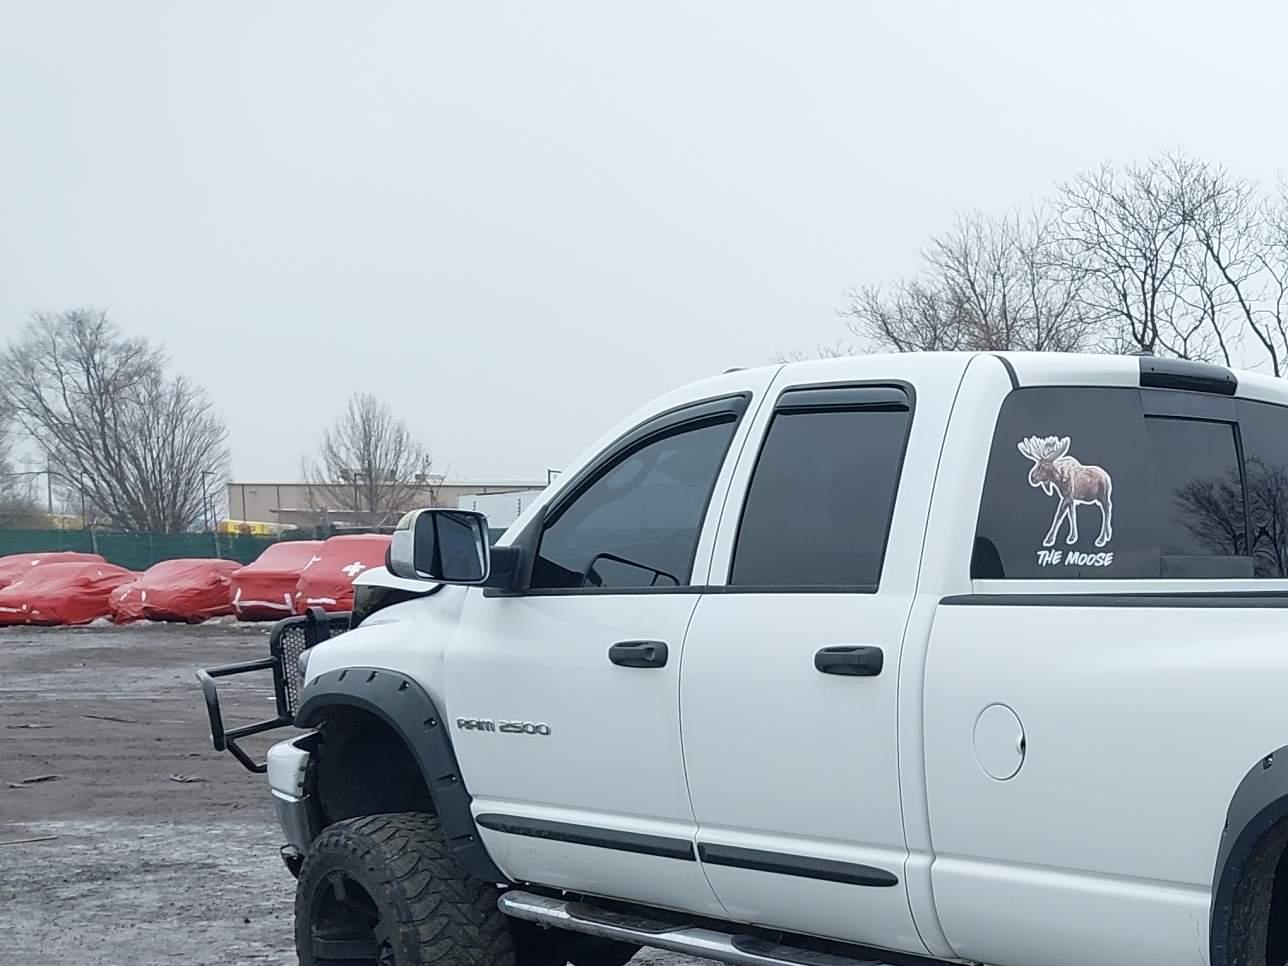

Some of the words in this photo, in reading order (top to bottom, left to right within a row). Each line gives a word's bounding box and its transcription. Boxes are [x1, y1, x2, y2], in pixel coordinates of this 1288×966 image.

[1036, 549, 1063, 567] THE
[1064, 550, 1114, 567] MOOSE
[457, 718, 496, 733] RAM
[499, 721, 551, 736] 2500
